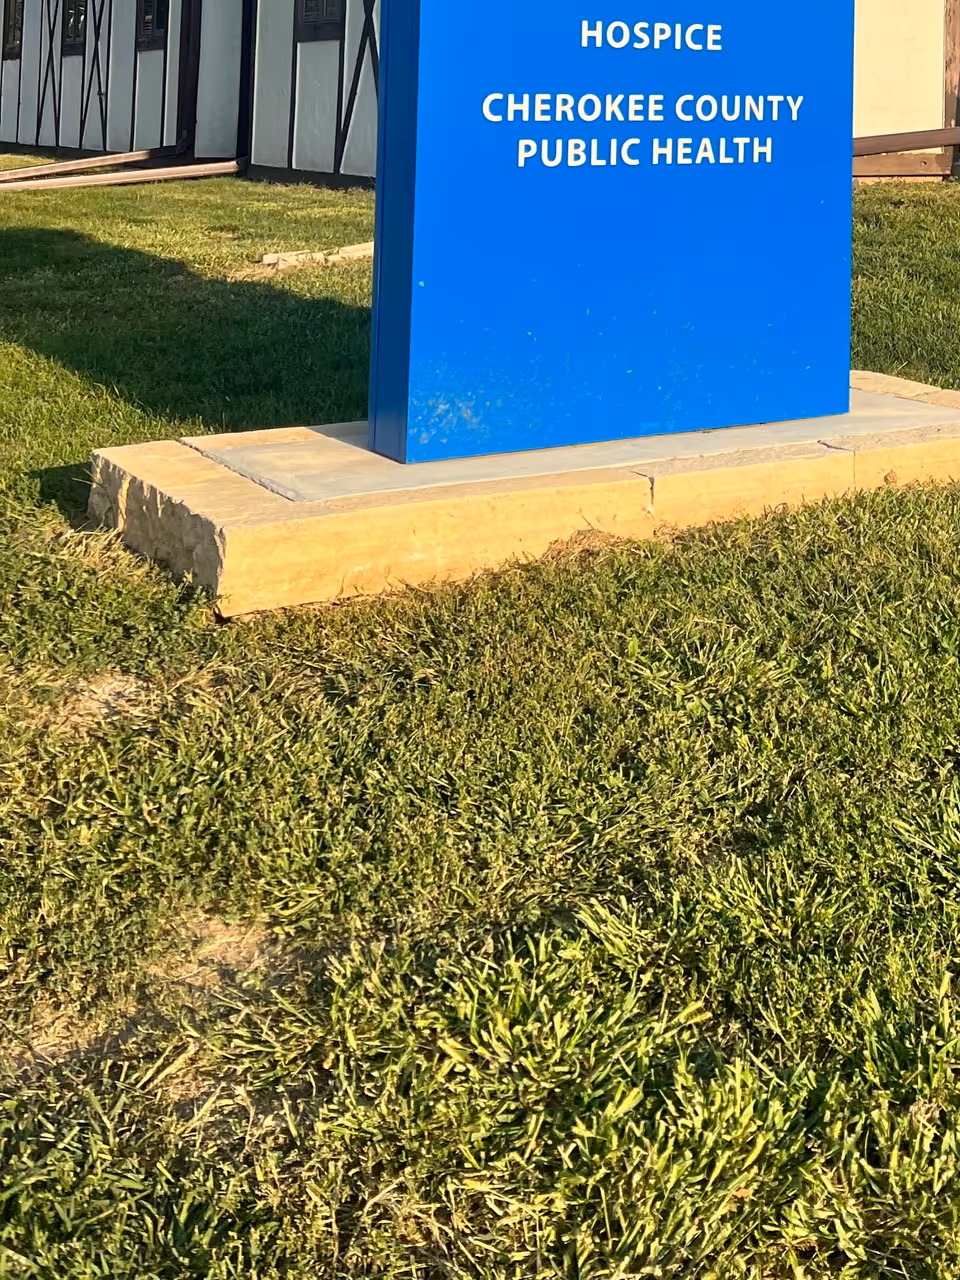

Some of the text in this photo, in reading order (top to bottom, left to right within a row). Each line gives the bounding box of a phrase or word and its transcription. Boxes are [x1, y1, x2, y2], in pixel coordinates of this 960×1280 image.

[580, 20, 724, 51] HOSPICE
[482, 92, 804, 122] CHEROKEE COUNTY
[517, 136, 773, 168] PUBLIC HEALTH
